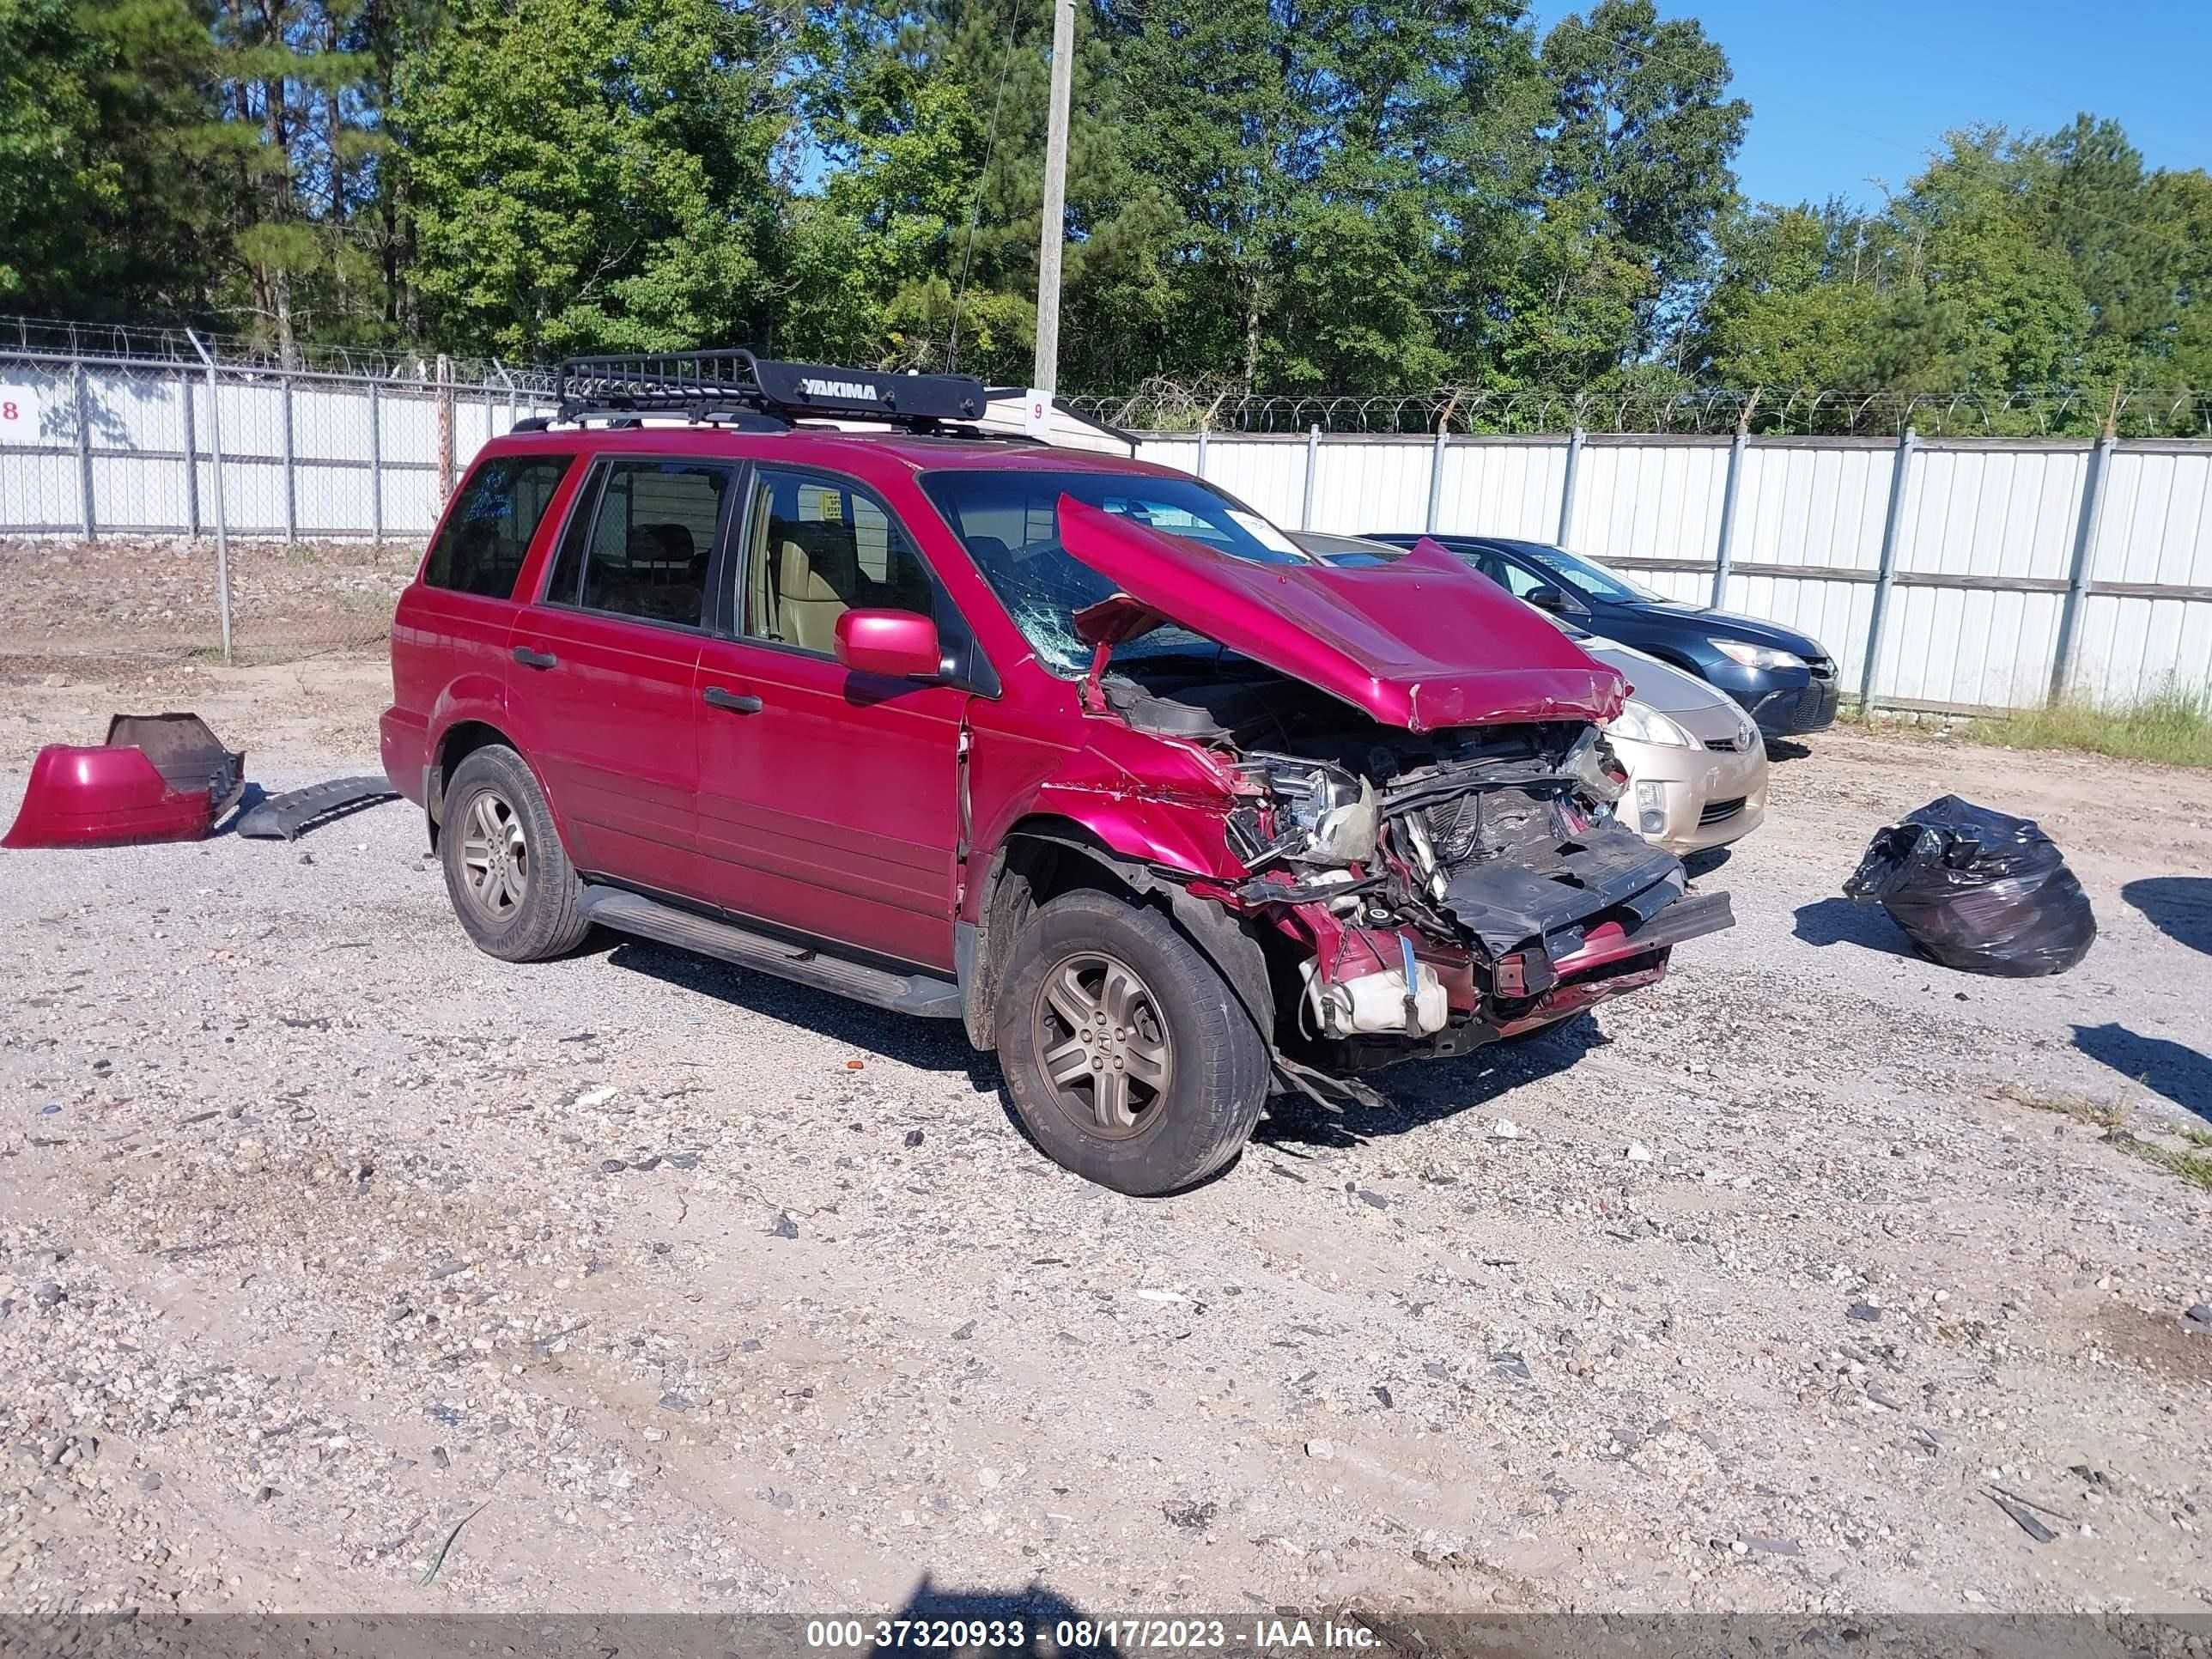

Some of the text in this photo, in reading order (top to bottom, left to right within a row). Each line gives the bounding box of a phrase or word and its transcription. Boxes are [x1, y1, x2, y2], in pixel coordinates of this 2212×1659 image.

[801, 378, 878, 401] YAKIMA
[3, 402, 18, 420] 8
[1034, 404, 1042, 419] 9
